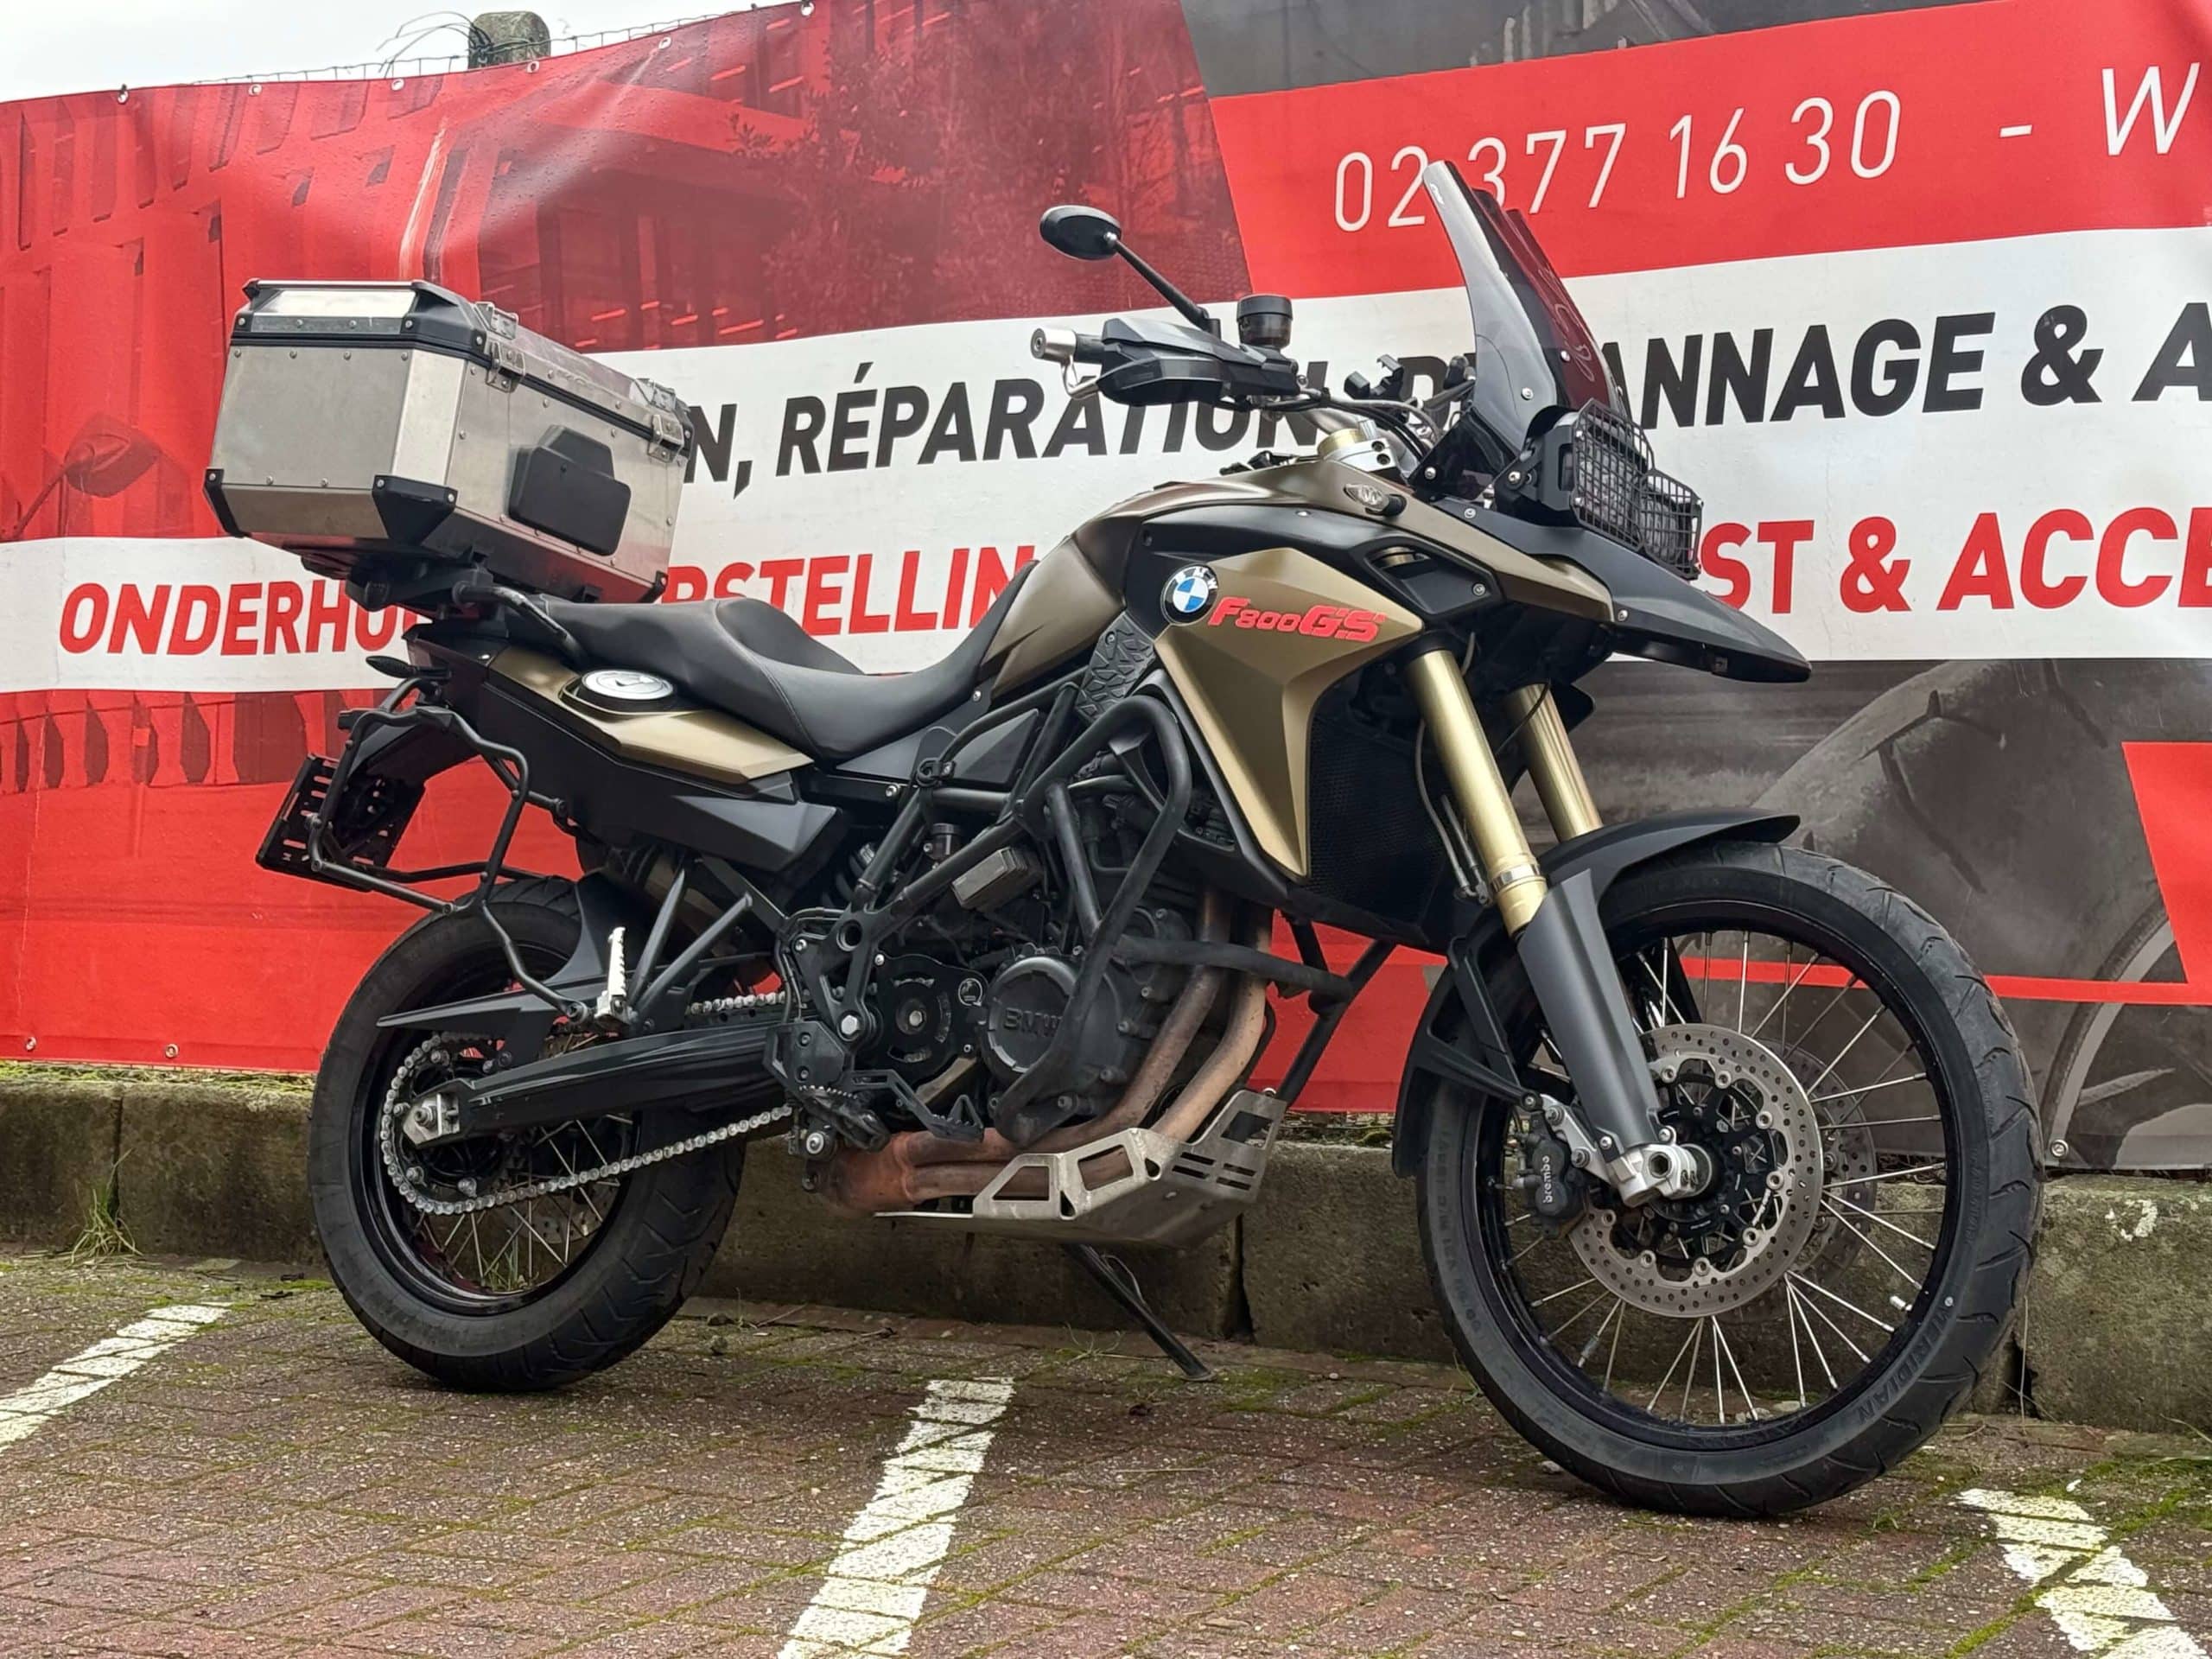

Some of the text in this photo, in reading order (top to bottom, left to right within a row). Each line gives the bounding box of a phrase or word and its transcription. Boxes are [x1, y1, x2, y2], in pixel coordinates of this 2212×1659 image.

[1335, 145, 1429, 232] 02
[1467, 124, 1626, 214] 377
[1669, 108, 1748, 199] 16
[1785, 90, 1901, 185] 30
[2020, 305, 2104, 406] &
[60, 579, 418, 655] ONDERHO
[1840, 516, 1912, 612] &
[1175, 565, 1219, 591] BMW
[1003, 1007, 1064, 1038] BMW
[1540, 1155, 1554, 1204] brembo
